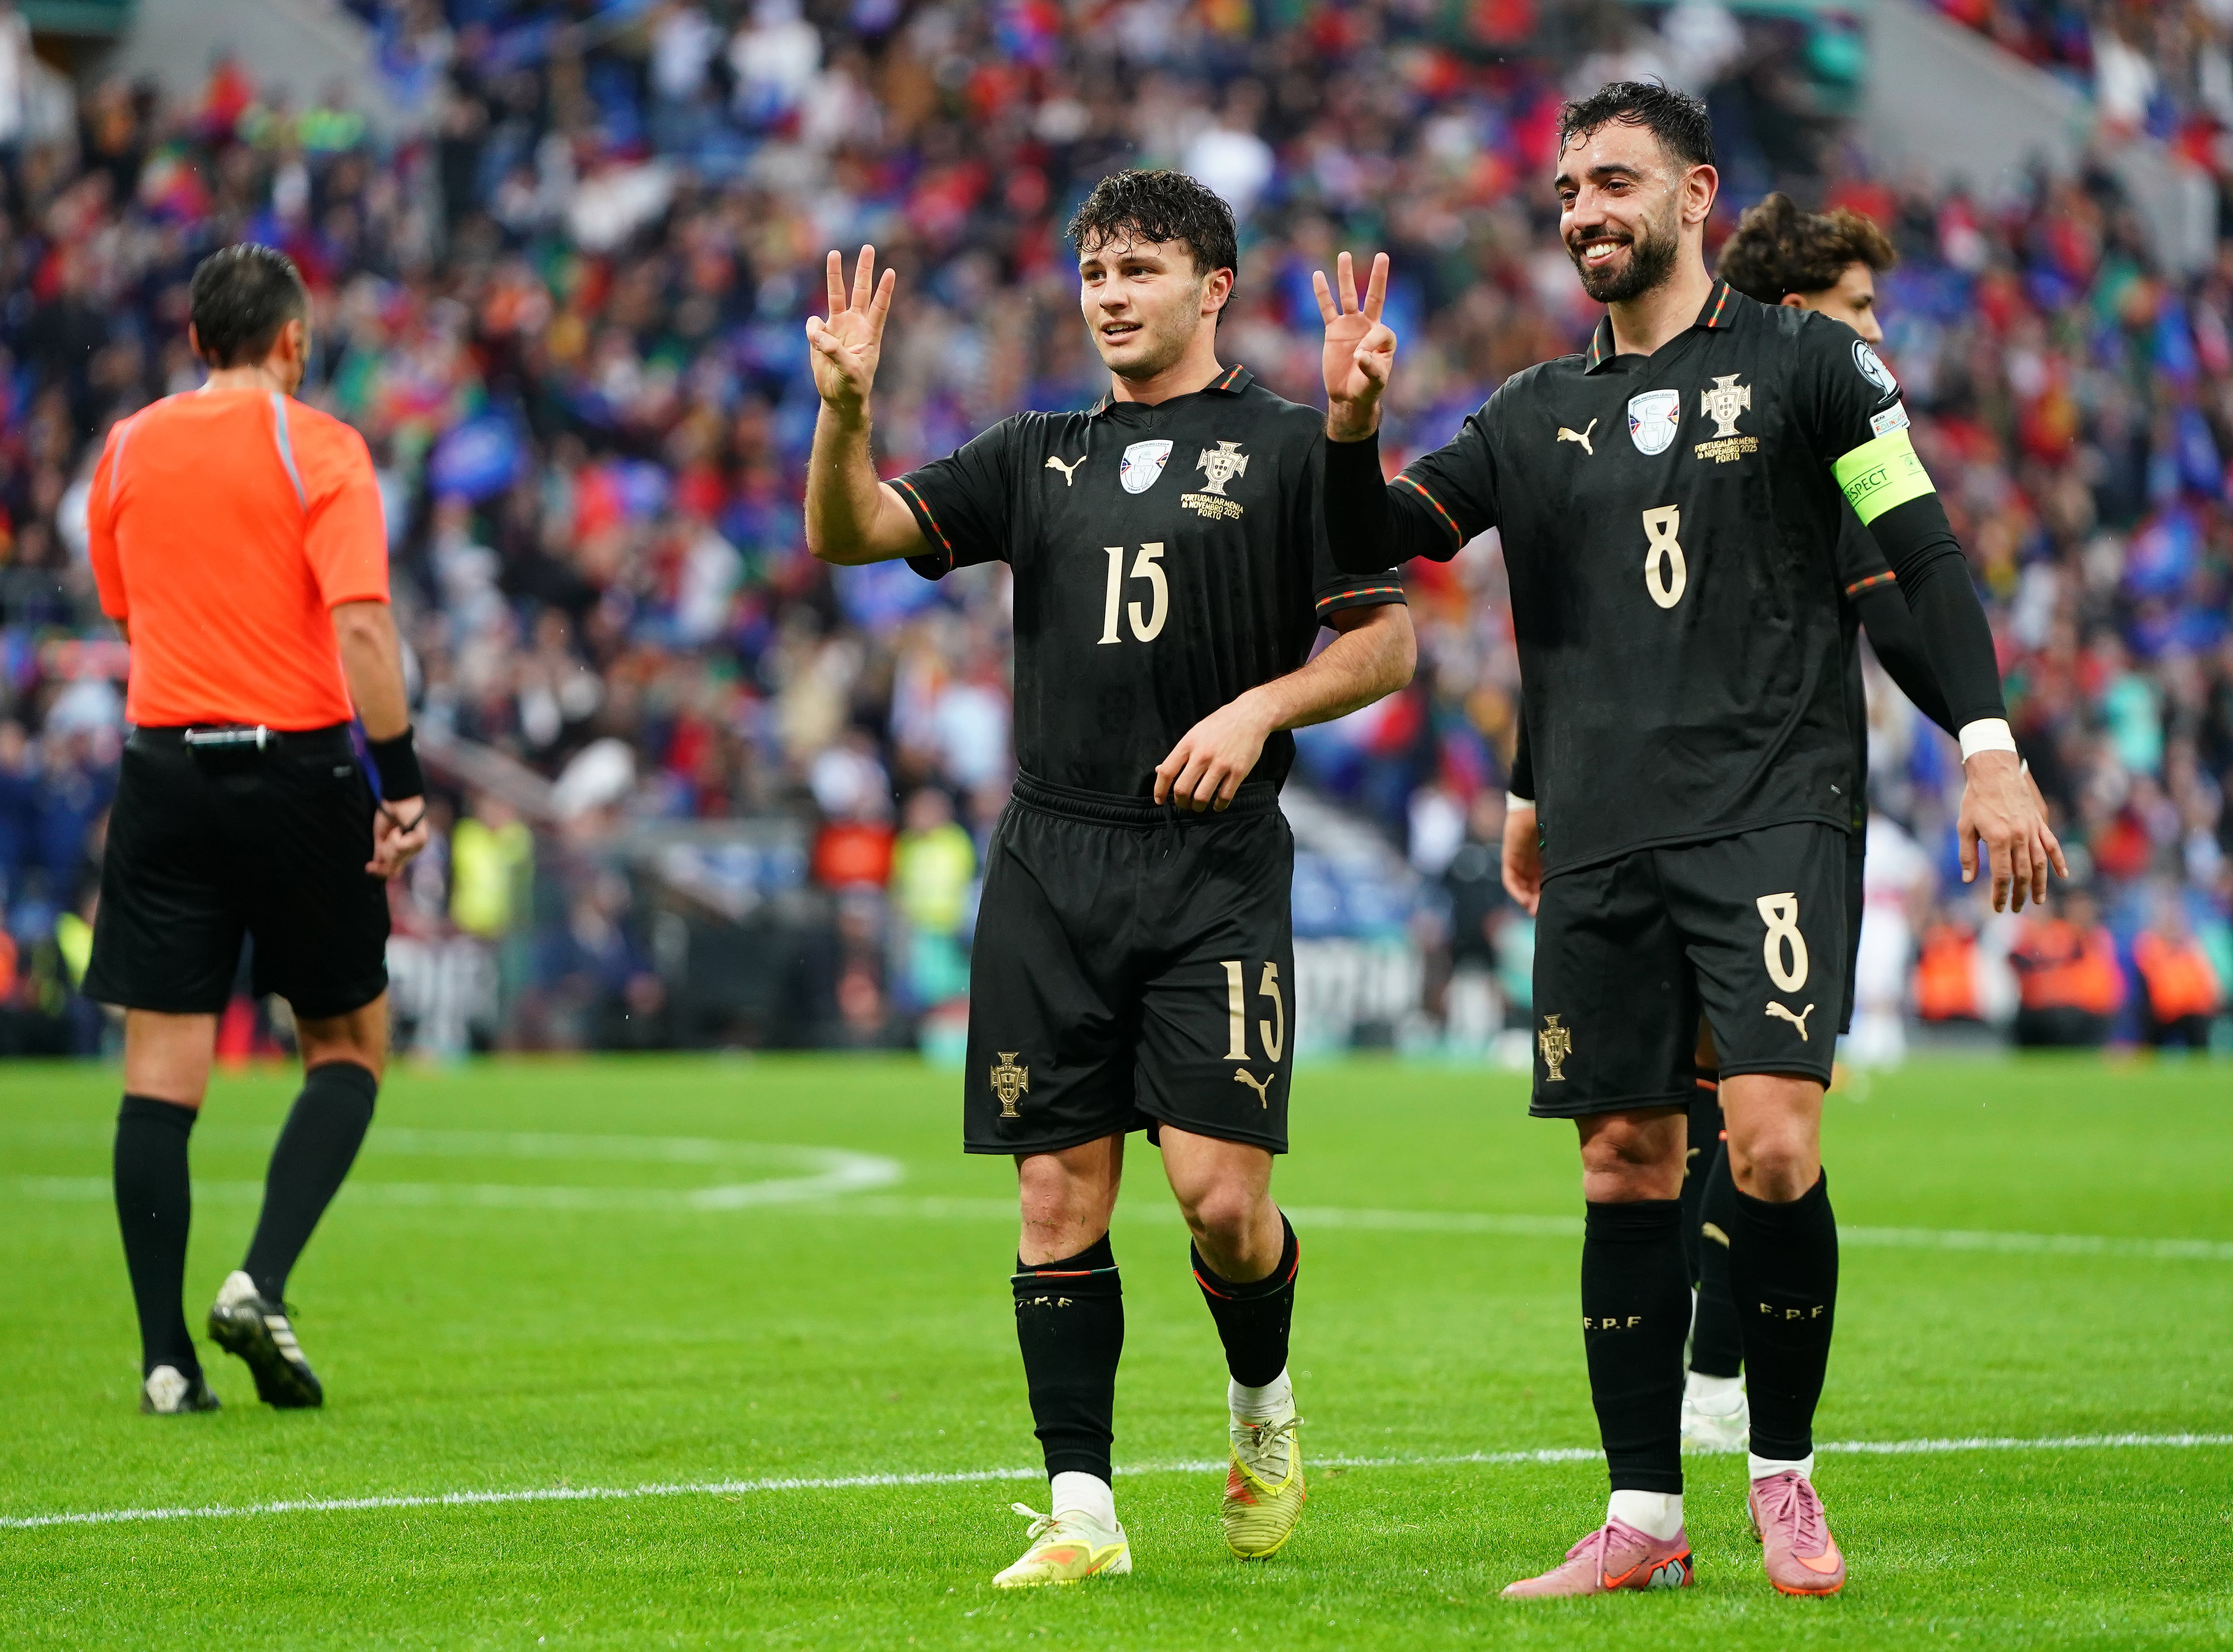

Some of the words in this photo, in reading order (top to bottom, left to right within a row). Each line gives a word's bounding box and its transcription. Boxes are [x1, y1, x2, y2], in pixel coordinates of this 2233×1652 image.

[1704, 445, 1740, 457] NOVEMBRO
[1740, 444, 1757, 453] 2025
[1715, 452, 1740, 464] PORTO
[1189, 501, 1224, 513] NOVEMBRO
[1223, 507, 1240, 519] 2025
[1197, 509, 1222, 520] PORTO
[1642, 504, 1686, 609] 8
[1096, 542, 1169, 644] 15
[1756, 892, 1809, 993] 8
[1219, 960, 1284, 1063] 15
